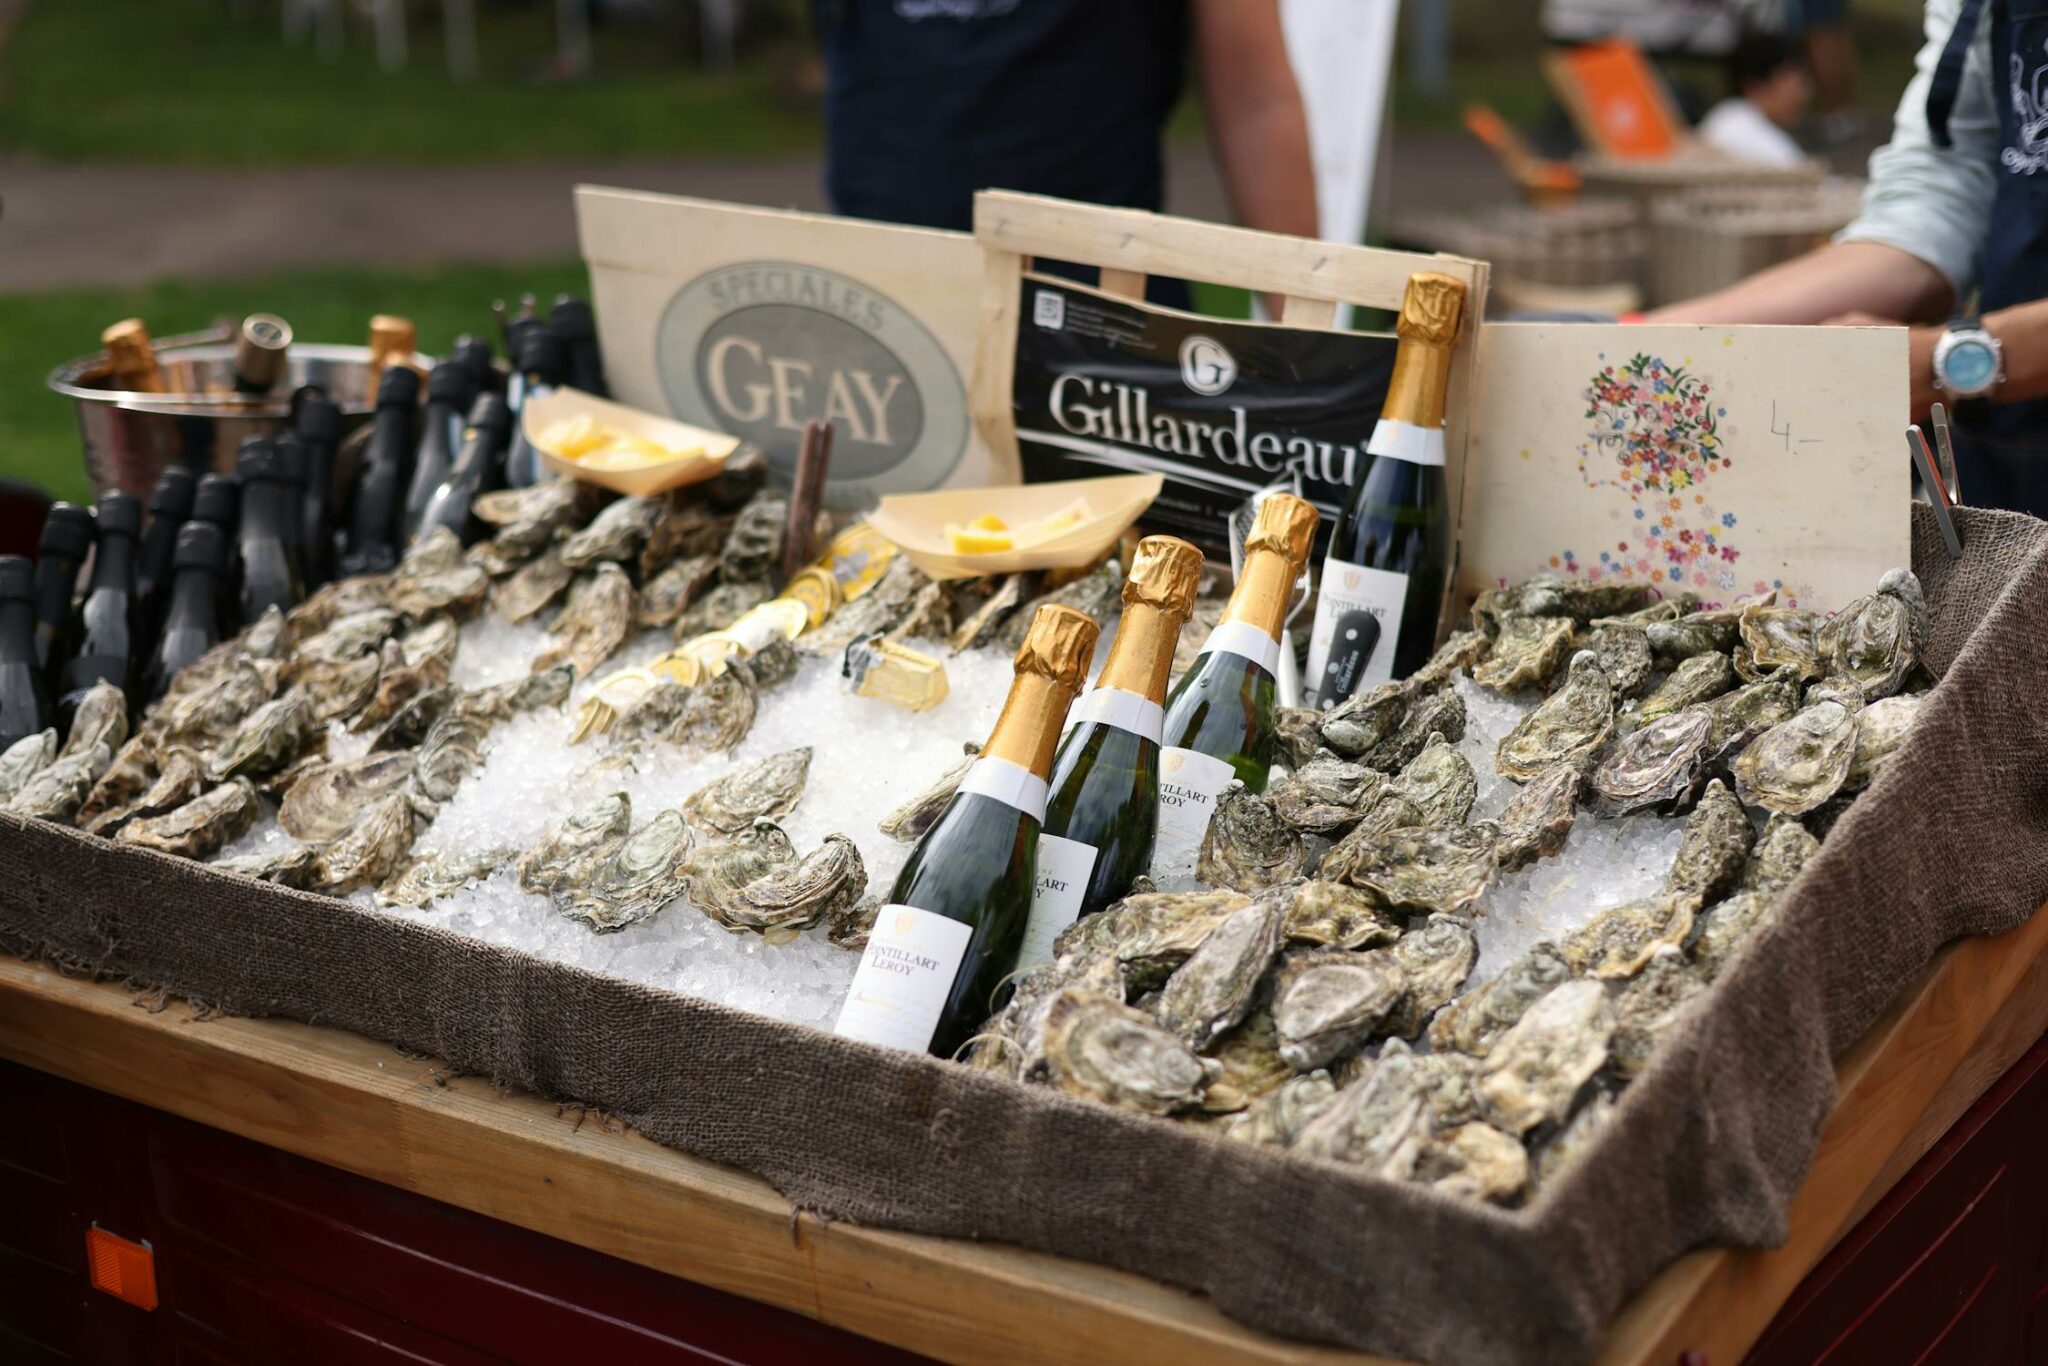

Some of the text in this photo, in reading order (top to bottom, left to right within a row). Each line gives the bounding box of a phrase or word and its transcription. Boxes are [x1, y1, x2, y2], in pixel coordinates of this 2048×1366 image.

[708, 336, 902, 446] GEAY
[1049, 372, 1356, 486] Gillardeau
[1159, 794, 1187, 807] ROY
[872, 955, 915, 976] LEROY
